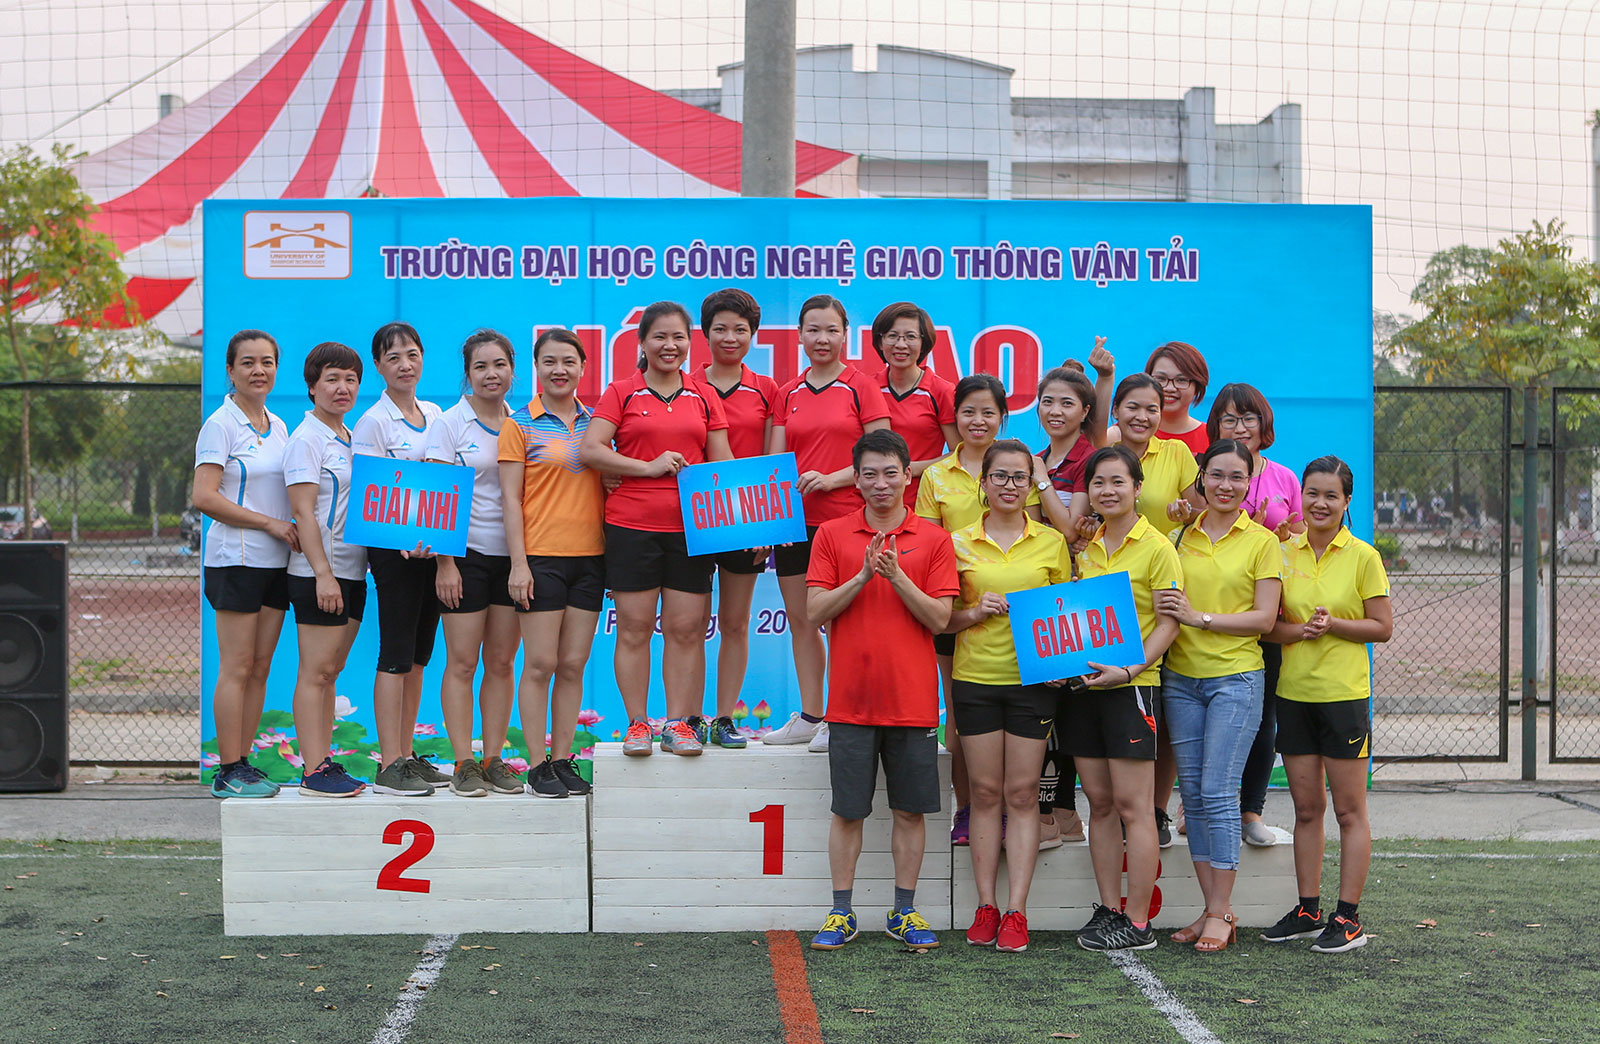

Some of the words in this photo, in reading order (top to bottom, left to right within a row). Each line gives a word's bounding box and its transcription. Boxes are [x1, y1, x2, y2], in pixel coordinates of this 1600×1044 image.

[382, 238, 511, 278] TRƯỜNG
[523, 248, 577, 283] ĐẠI
[590, 247, 653, 283] HỌC
[667, 241, 755, 278] CÔNG
[767, 241, 854, 284] NGHỆ
[866, 248, 942, 278] GIAO
[953, 242, 1060, 279] THÔNG
[1071, 243, 1137, 286] VẬN
[1147, 237, 1198, 280] TẢI
[362, 470, 411, 526] GIẢI
[416, 484, 459, 531] NHÌ
[691, 473, 735, 530] GIẢI
[738, 468, 793, 524] NHẤT
[1032, 597, 1084, 658] GIẢI
[1086, 605, 1124, 649] BA
[376, 819, 435, 894] 2
[749, 804, 785, 876] 1
